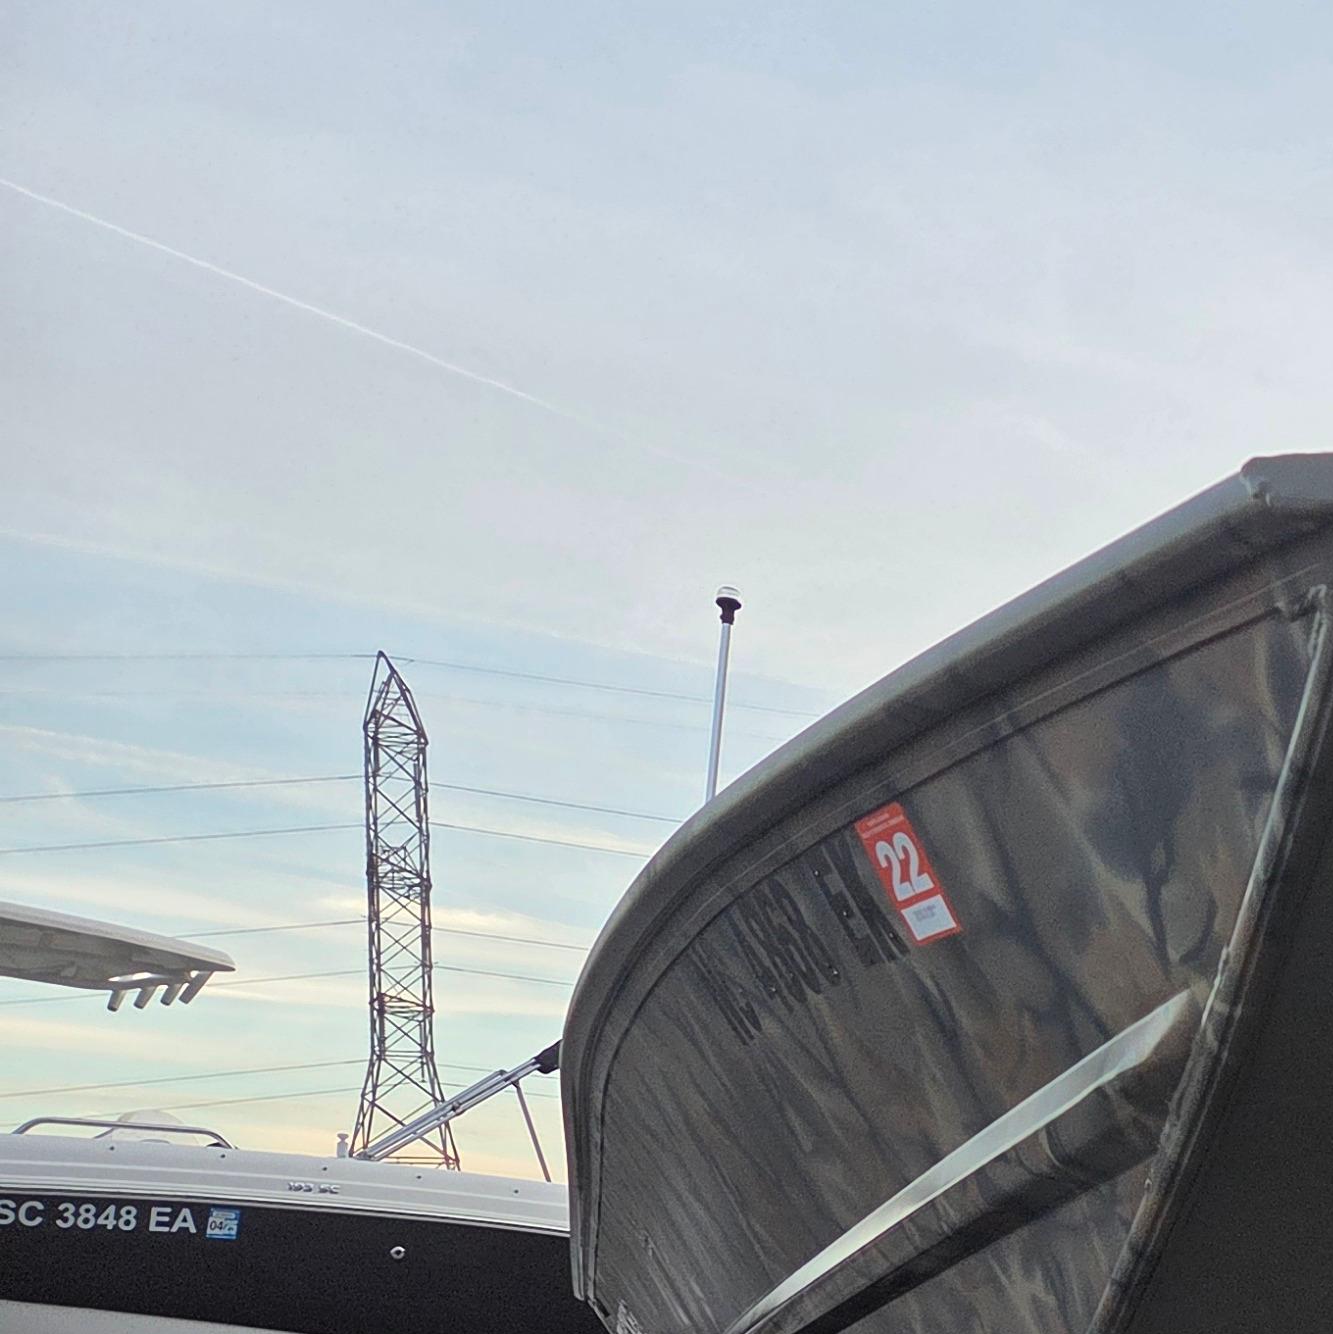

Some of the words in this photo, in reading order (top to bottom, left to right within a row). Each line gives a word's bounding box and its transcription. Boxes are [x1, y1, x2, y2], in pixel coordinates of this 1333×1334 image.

[875, 832, 935, 902] 22
[0, 1200, 45, 1227] SC
[55, 1202, 138, 1232] 3848
[149, 1206, 198, 1234] EA
